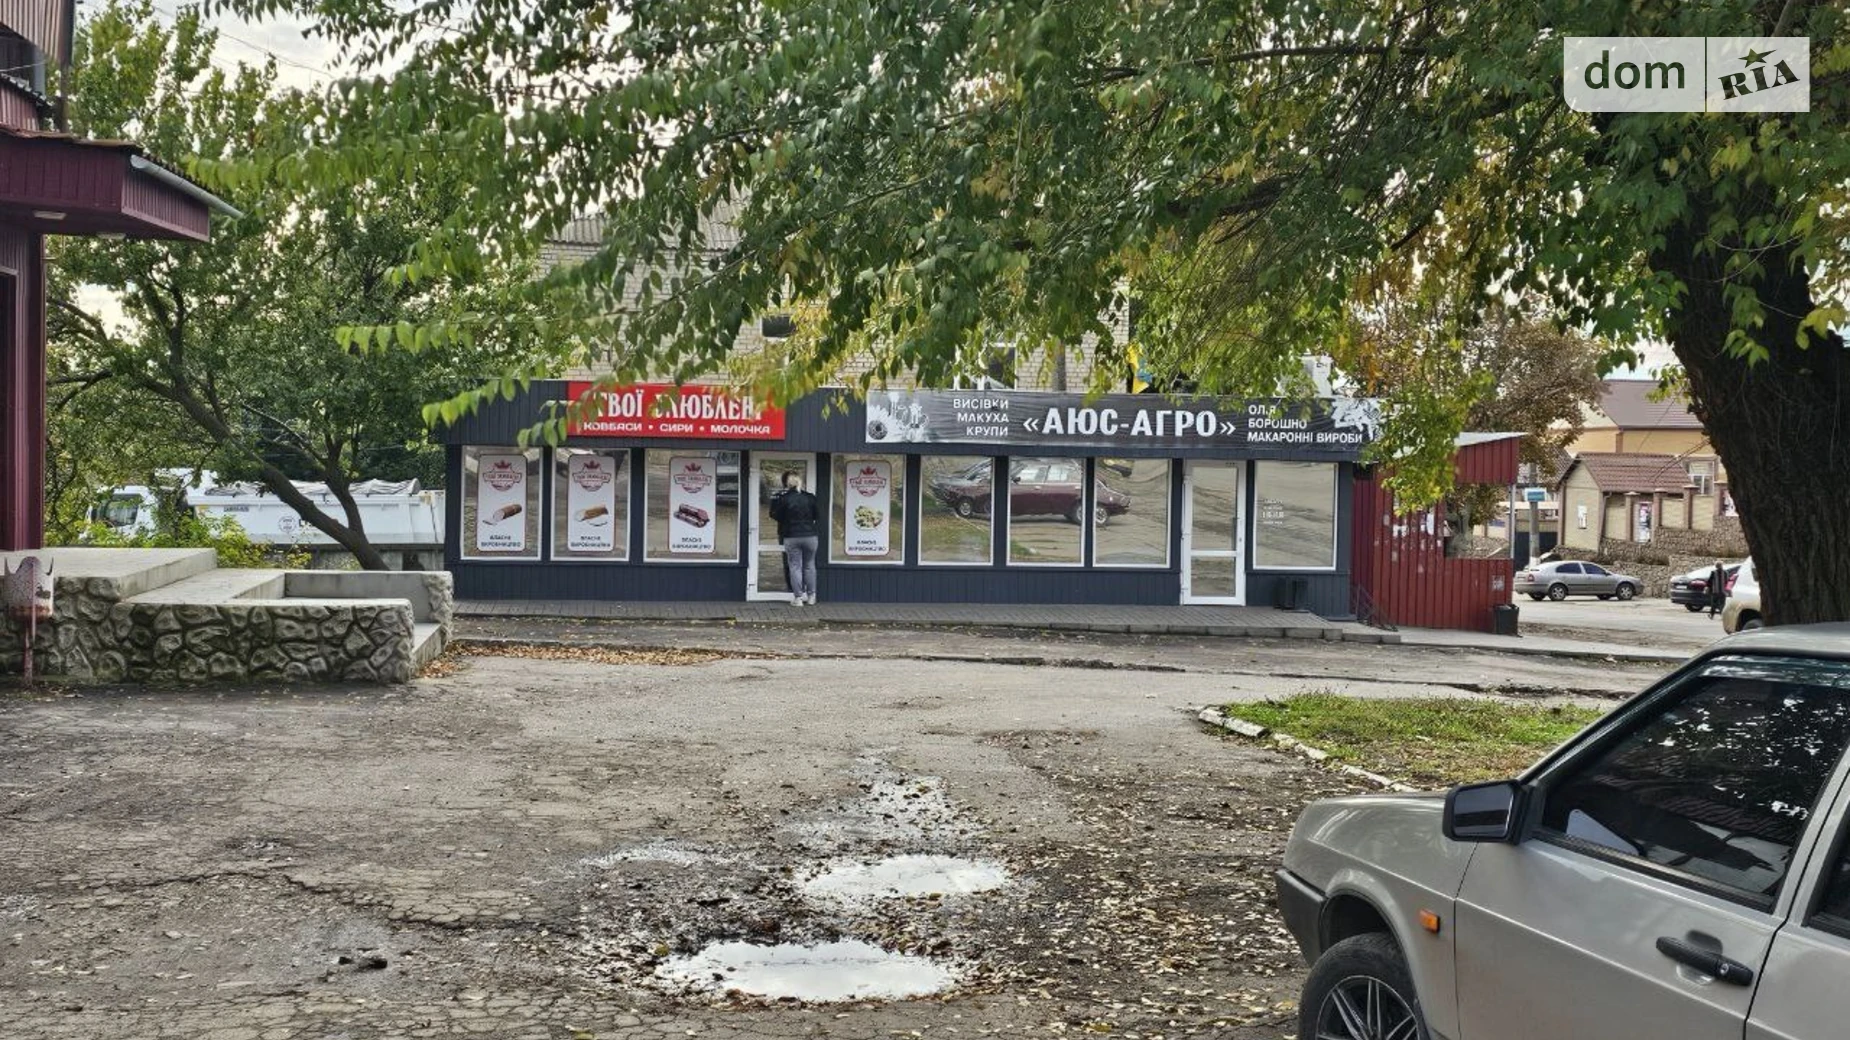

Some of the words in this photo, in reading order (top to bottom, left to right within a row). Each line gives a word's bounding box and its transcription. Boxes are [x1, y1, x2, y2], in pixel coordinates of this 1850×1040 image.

[953, 398, 1009, 410] ВИСІВКИ
[957, 411, 1009, 423] МАКУХА
[1023, 406, 1236, 437] «АЮС-АГРО»
[583, 422, 642, 432] КОВБАСИ
[659, 423, 693, 433] СИРИ
[710, 424, 770, 434] МОЛОЧКА
[1248, 418, 1307, 429] БОРОШНО
[966, 426, 1008, 437] КРУПИ
[1247, 432, 1313, 442] МАКАРОННІ
[1316, 433, 1362, 443] ВИРОБИ
